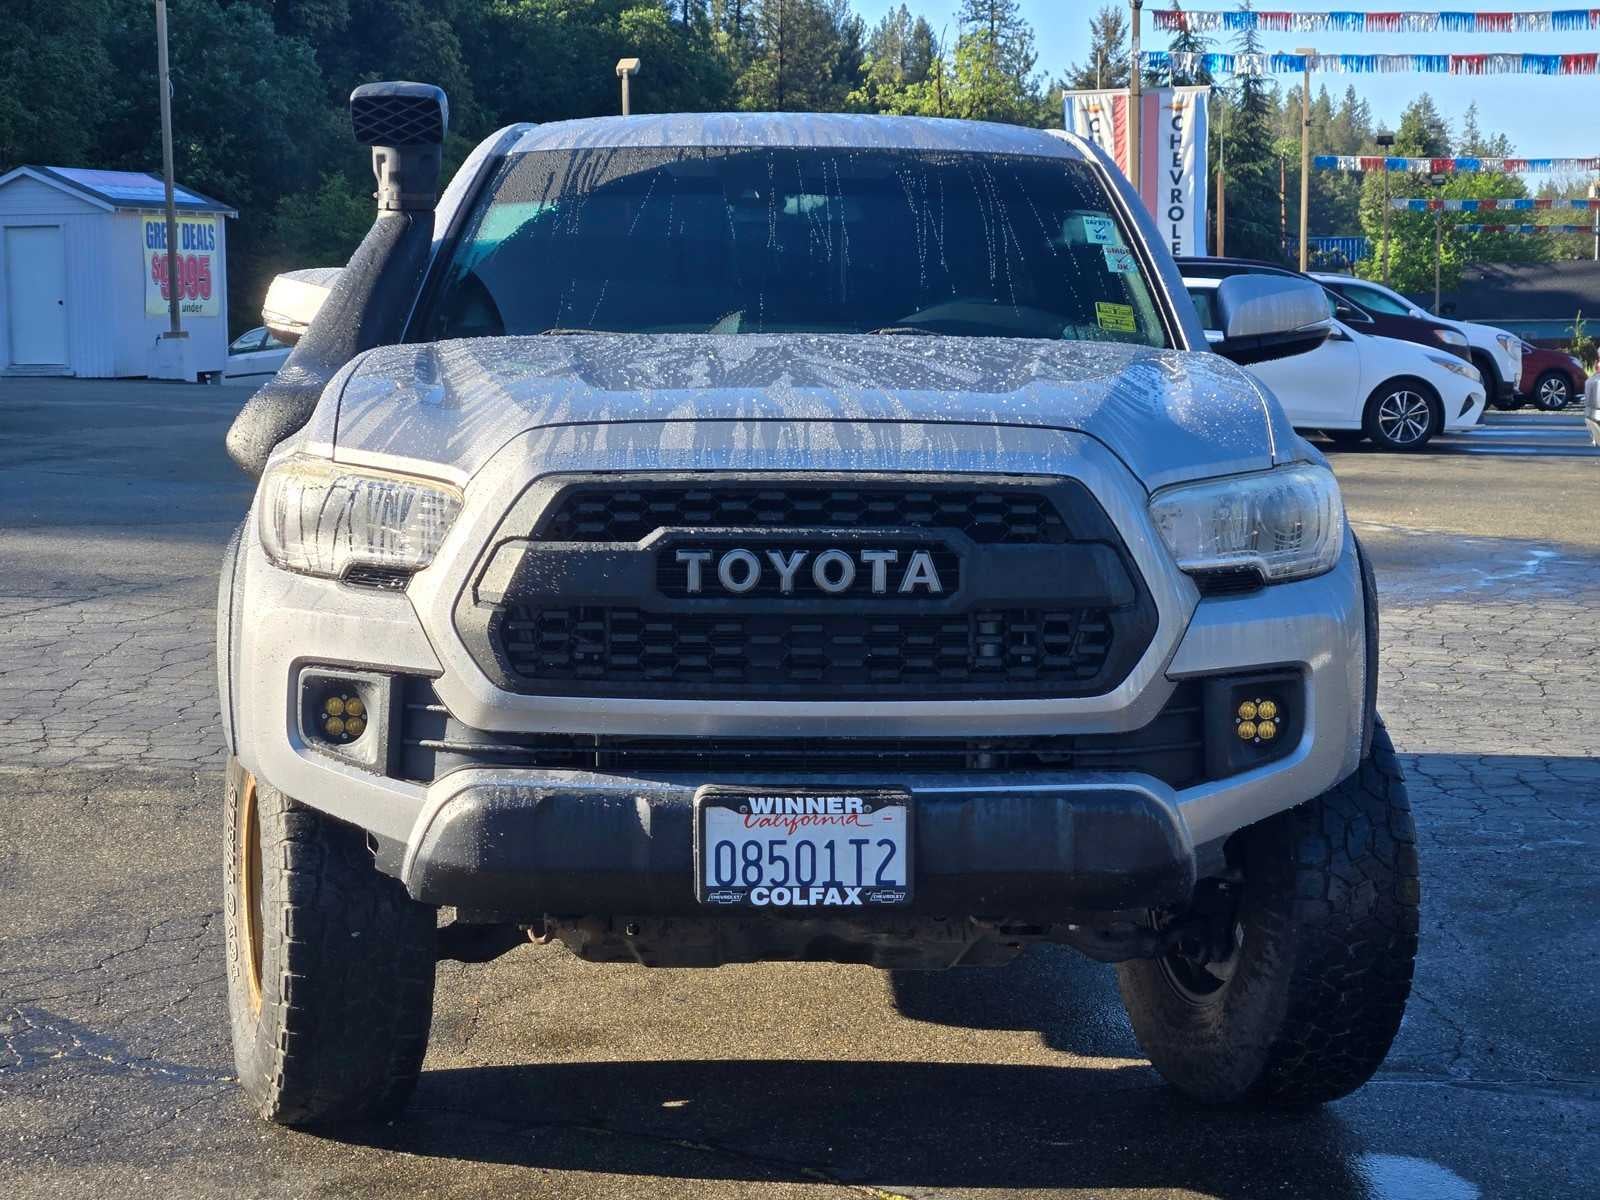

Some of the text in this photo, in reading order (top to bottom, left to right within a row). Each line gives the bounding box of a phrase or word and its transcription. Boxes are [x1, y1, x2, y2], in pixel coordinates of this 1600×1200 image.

[145, 221, 215, 251] GRET DEALS
[1117, 263, 1129, 271] OK
[182, 303, 204, 313] under
[674, 549, 944, 594] TOYOTA
[748, 797, 863, 814] WINNER
[744, 813, 873, 836] California
[714, 838, 897, 886] 08501T2
[750, 887, 863, 906] COLFAX
